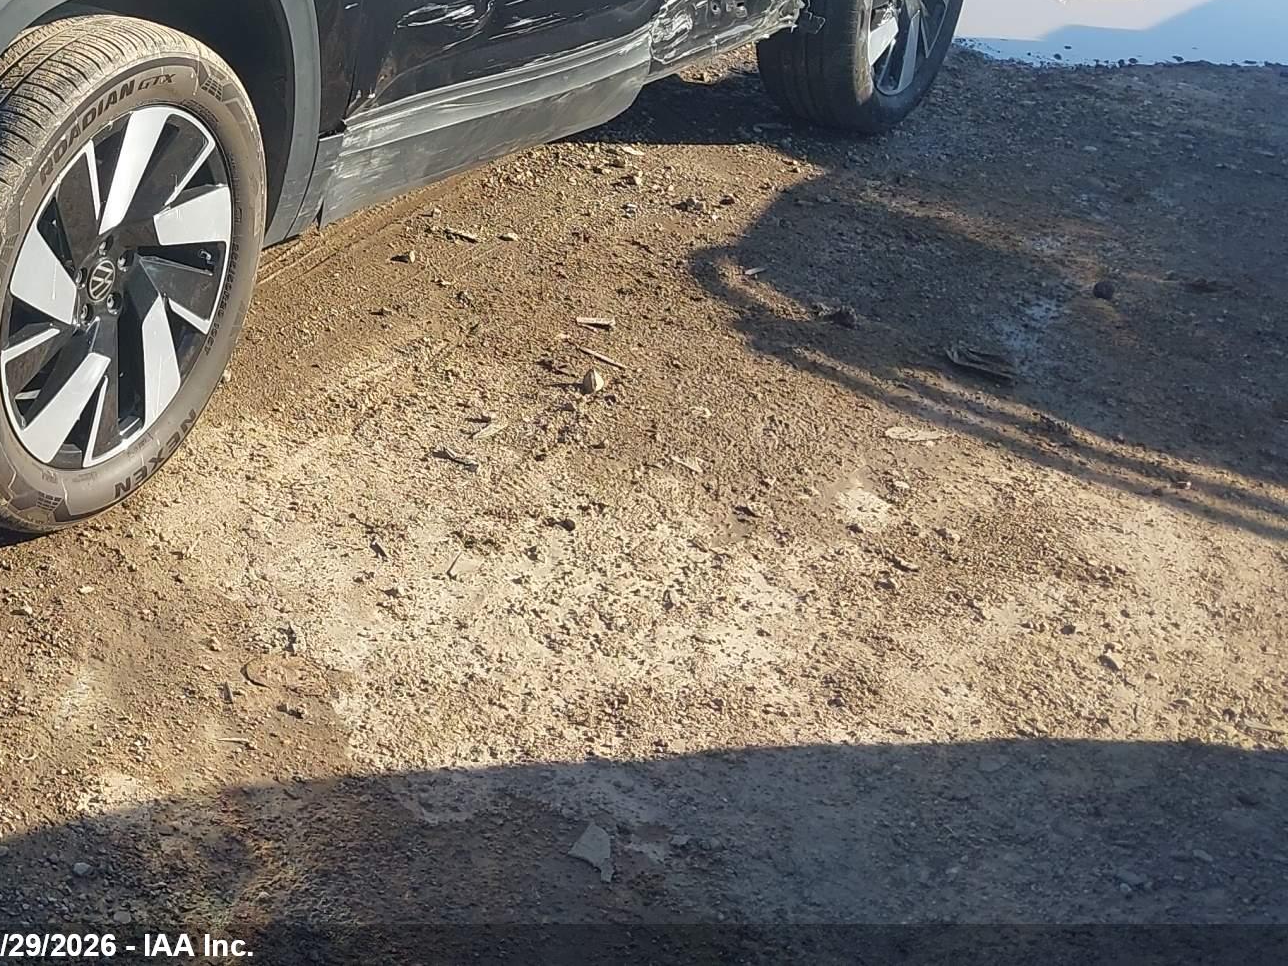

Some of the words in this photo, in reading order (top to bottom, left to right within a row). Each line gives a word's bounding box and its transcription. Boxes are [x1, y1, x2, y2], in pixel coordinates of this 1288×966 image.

[39, 79, 136, 184] ROADIAN
[137, 73, 177, 91] GTX
[114, 408, 197, 499] NEXEN
